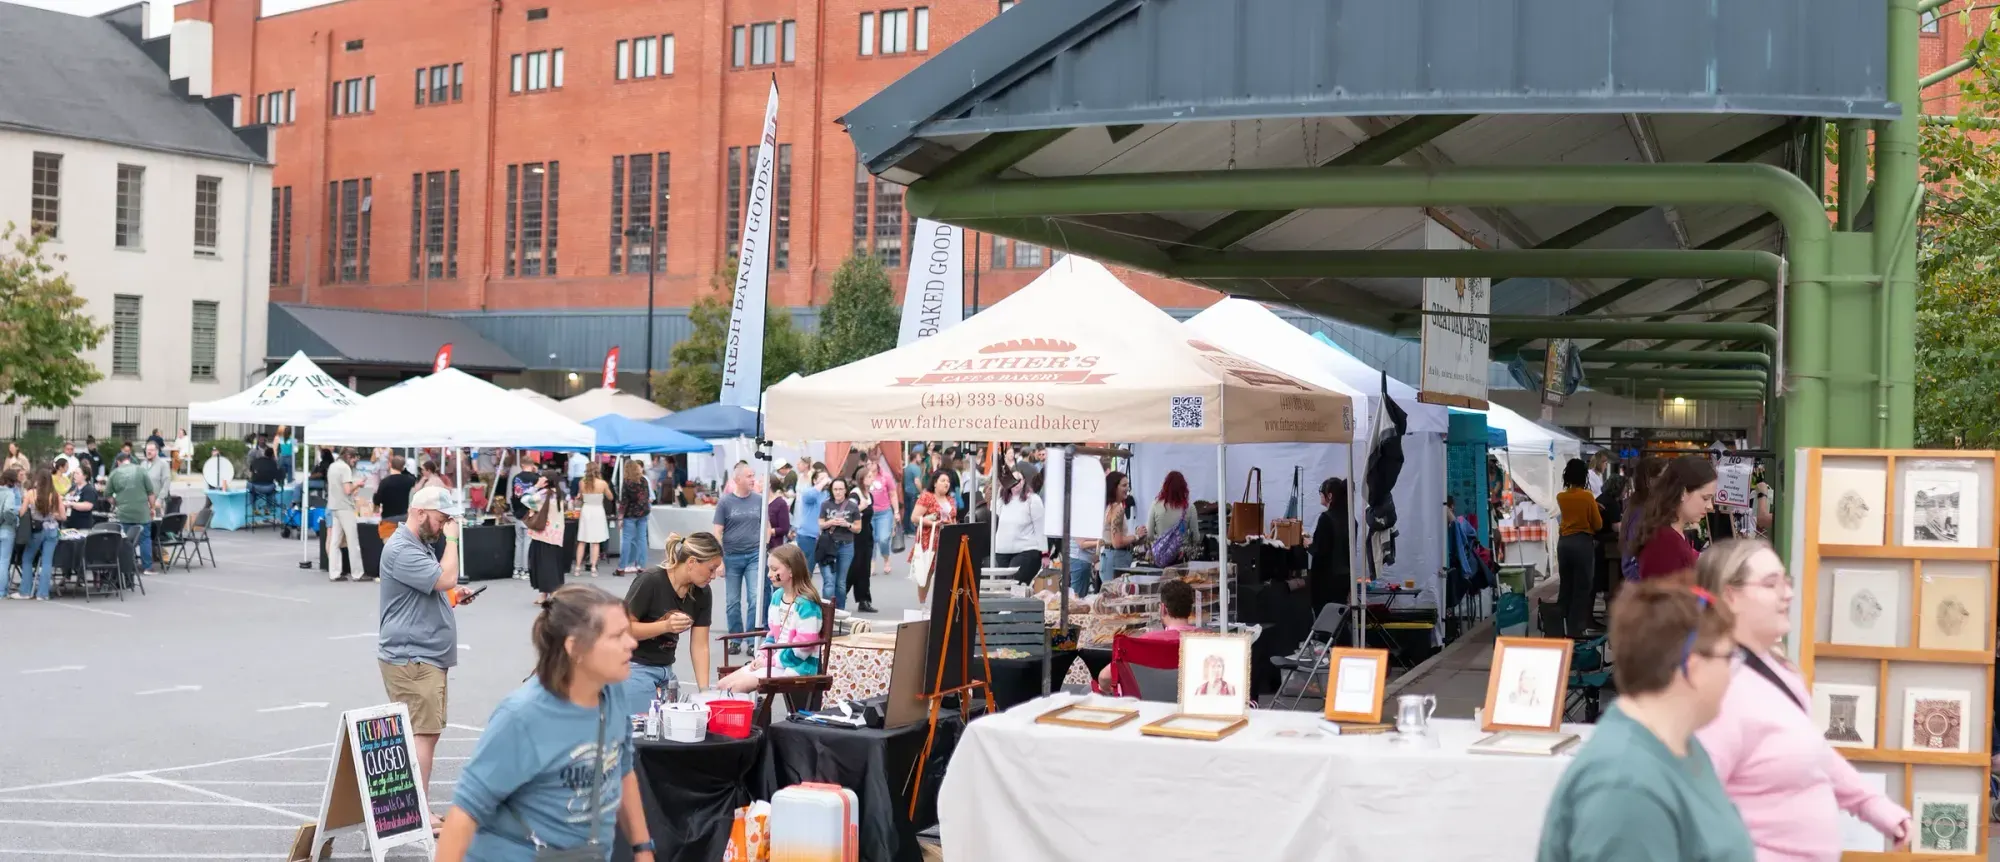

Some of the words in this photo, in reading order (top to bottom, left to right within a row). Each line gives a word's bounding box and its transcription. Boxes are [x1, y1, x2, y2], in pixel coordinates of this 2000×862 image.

[724, 320, 741, 388] FRESH
[735, 238, 755, 311] BAKED
[748, 157, 771, 233] GOODS
[918, 280, 944, 338] BAKED
[932, 355, 1100, 371] FATHER'S
[941, 374, 980, 383] CAFE
[999, 373, 1063, 381] BAKERY
[920, 392, 961, 408] (443)
[967, 393, 1045, 407] 333-8038
[871, 414, 1101, 433] www.fatherscafeandbakery
[1728, 456, 1741, 464] NO
[365, 745, 406, 776] CLOSED
